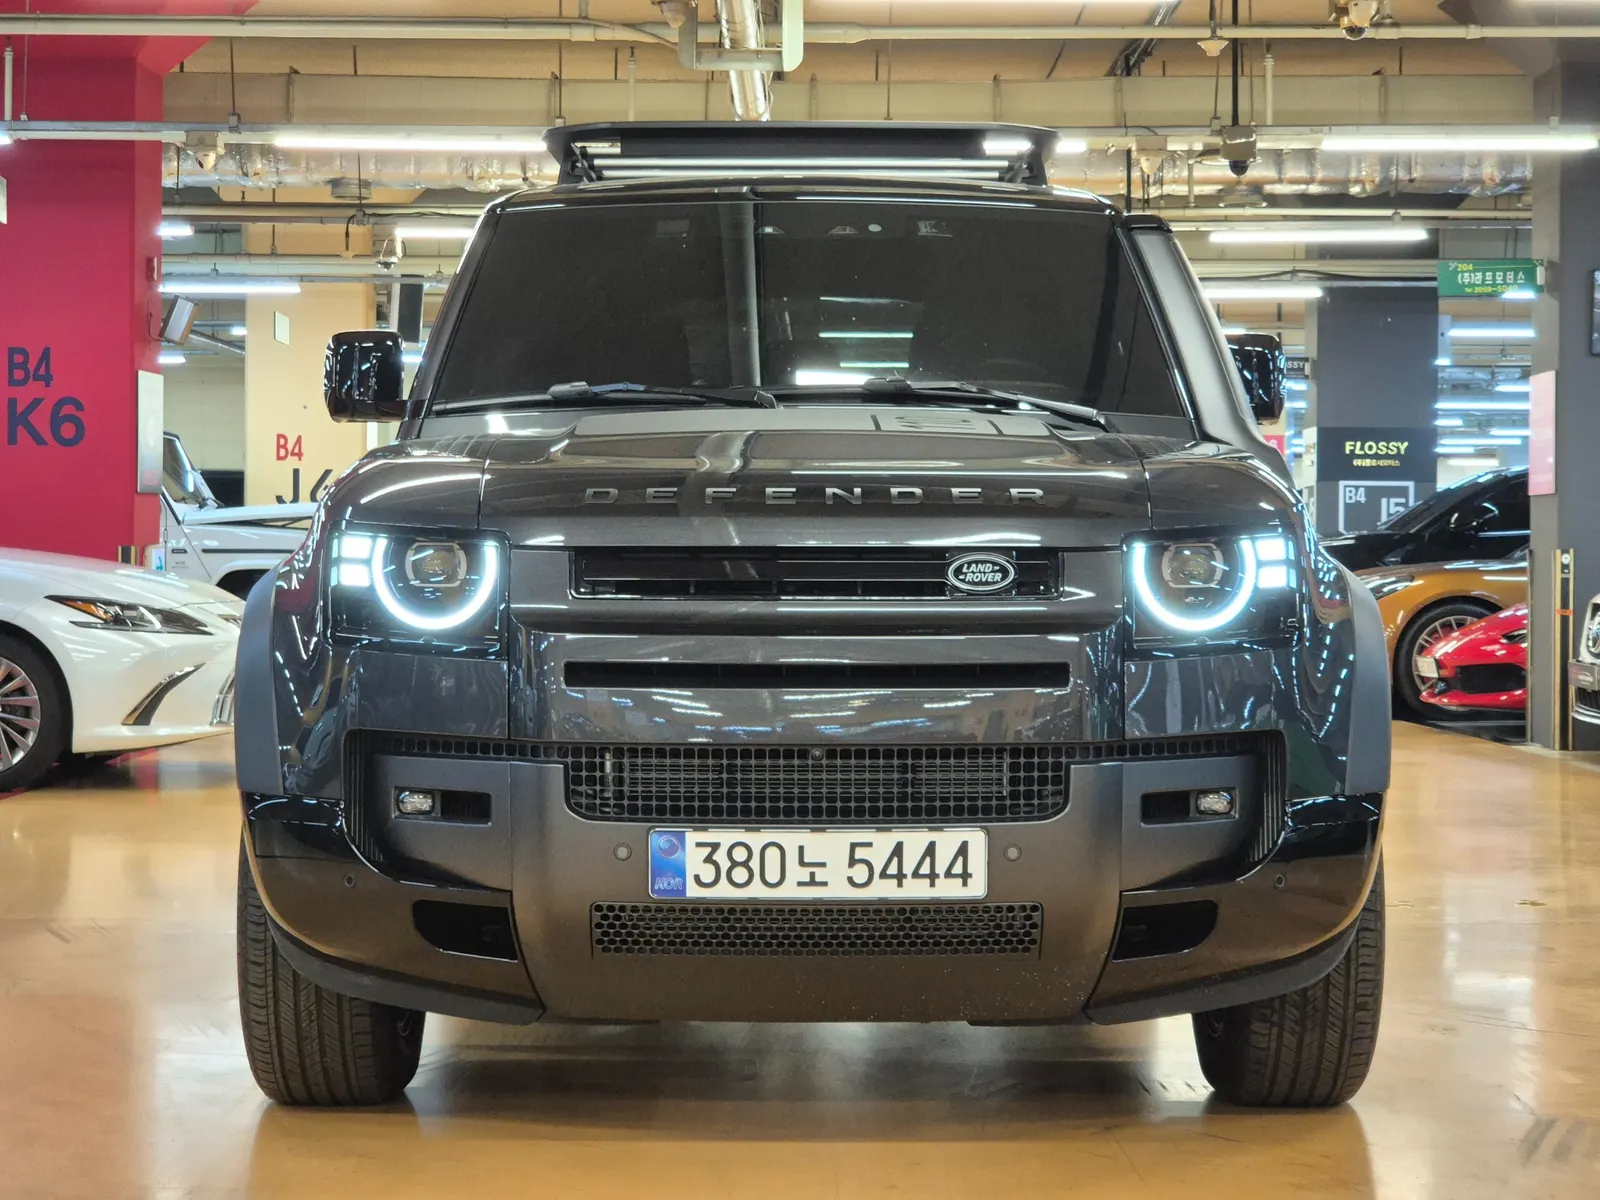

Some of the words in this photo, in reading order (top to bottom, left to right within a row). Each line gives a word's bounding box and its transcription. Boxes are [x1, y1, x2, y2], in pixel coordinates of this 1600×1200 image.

[7, 347, 53, 387] B4
[1286, 360, 1304, 369] SSY
[7, 397, 85, 447] K6
[276, 434, 304, 461] B4
[1345, 441, 1408, 455] FLOSSY
[584, 487, 1046, 505] DEFENDER
[1345, 488, 1366, 503] B4
[962, 563, 993, 573] LAND
[965, 573, 1003, 582] ROVER
[693, 840, 829, 888] 380노
[846, 840, 973, 888] 5444
[654, 877, 684, 890] KOR
